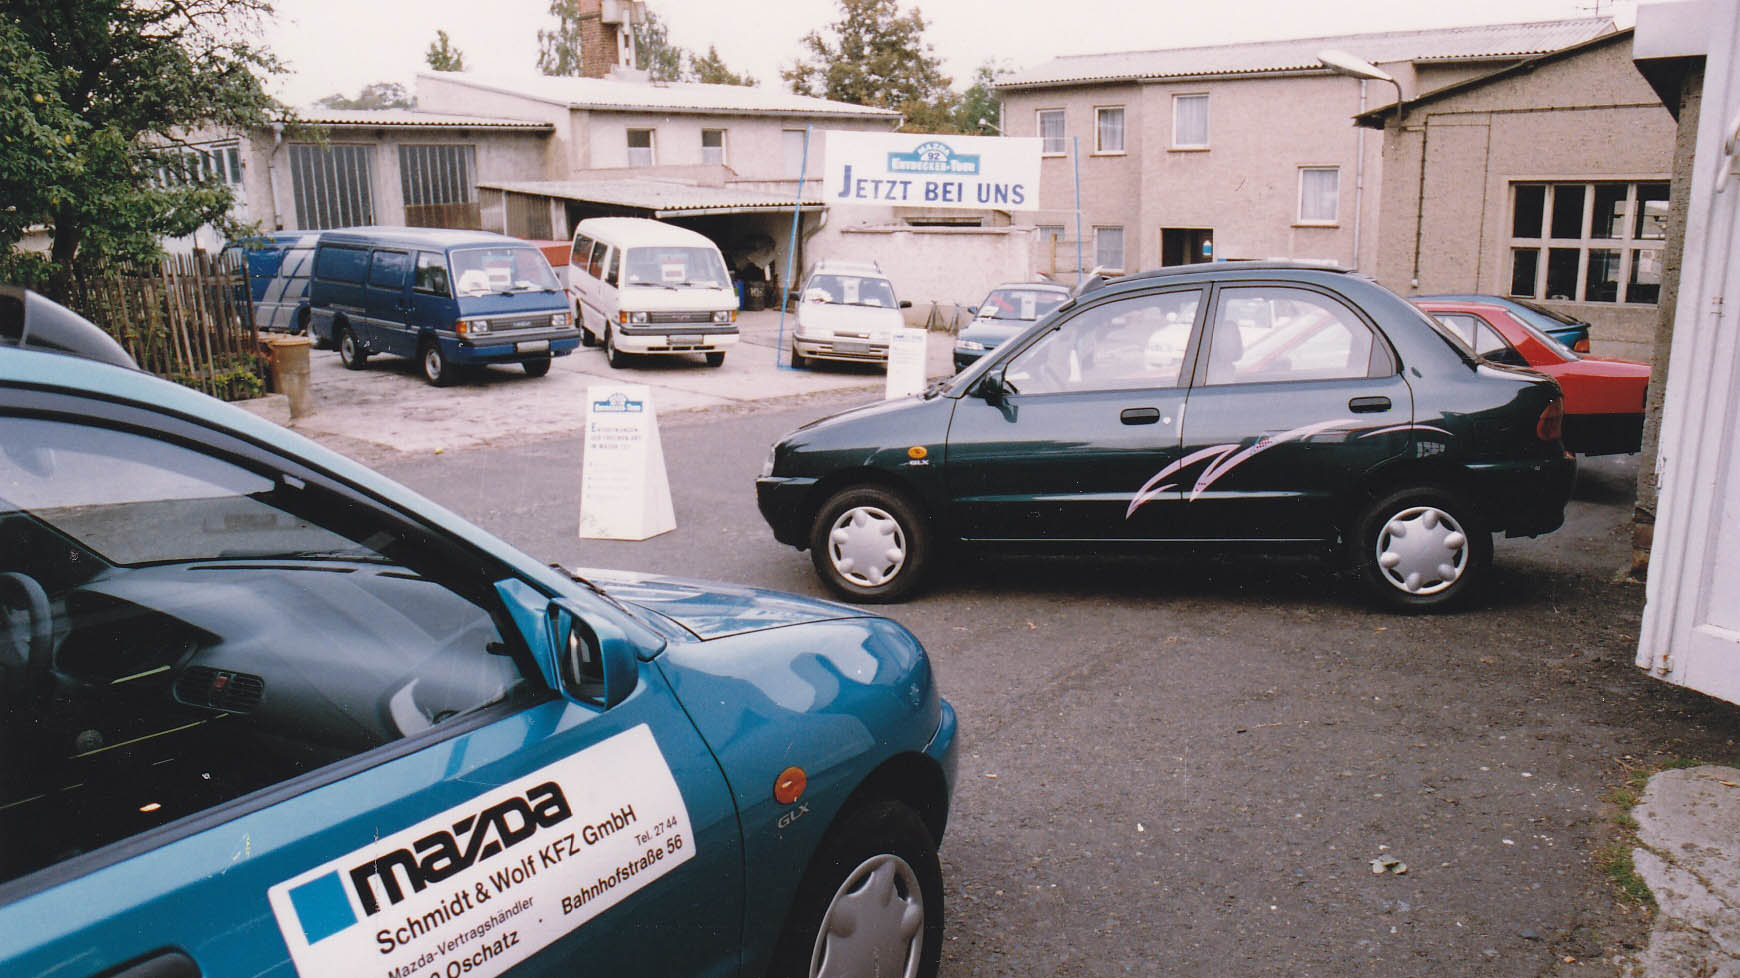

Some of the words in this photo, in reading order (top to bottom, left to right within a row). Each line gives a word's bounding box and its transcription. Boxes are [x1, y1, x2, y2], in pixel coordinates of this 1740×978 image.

[838, 165, 912, 201] JETZT
[925, 181, 963, 202] BEI
[977, 183, 1025, 205] UNS
[928, 152, 940, 160] 92
[634, 830, 652, 846] Tel.
[654, 822, 665, 837] 27
[666, 816, 678, 829] 44
[778, 802, 811, 829] GLX
[350, 781, 572, 917] mazda
[376, 890, 474, 955] Schmidt
[475, 882, 491, 903] &
[489, 855, 537, 893] Wolf
[539, 833, 581, 869] KFZ
[582, 804, 637, 845] GmbH
[447, 930, 520, 978] Oschatz
[561, 848, 664, 915] Bahnhofstraße
[666, 834, 683, 854] 56
[388, 896, 534, 978] Mazda-Vertragshändler
